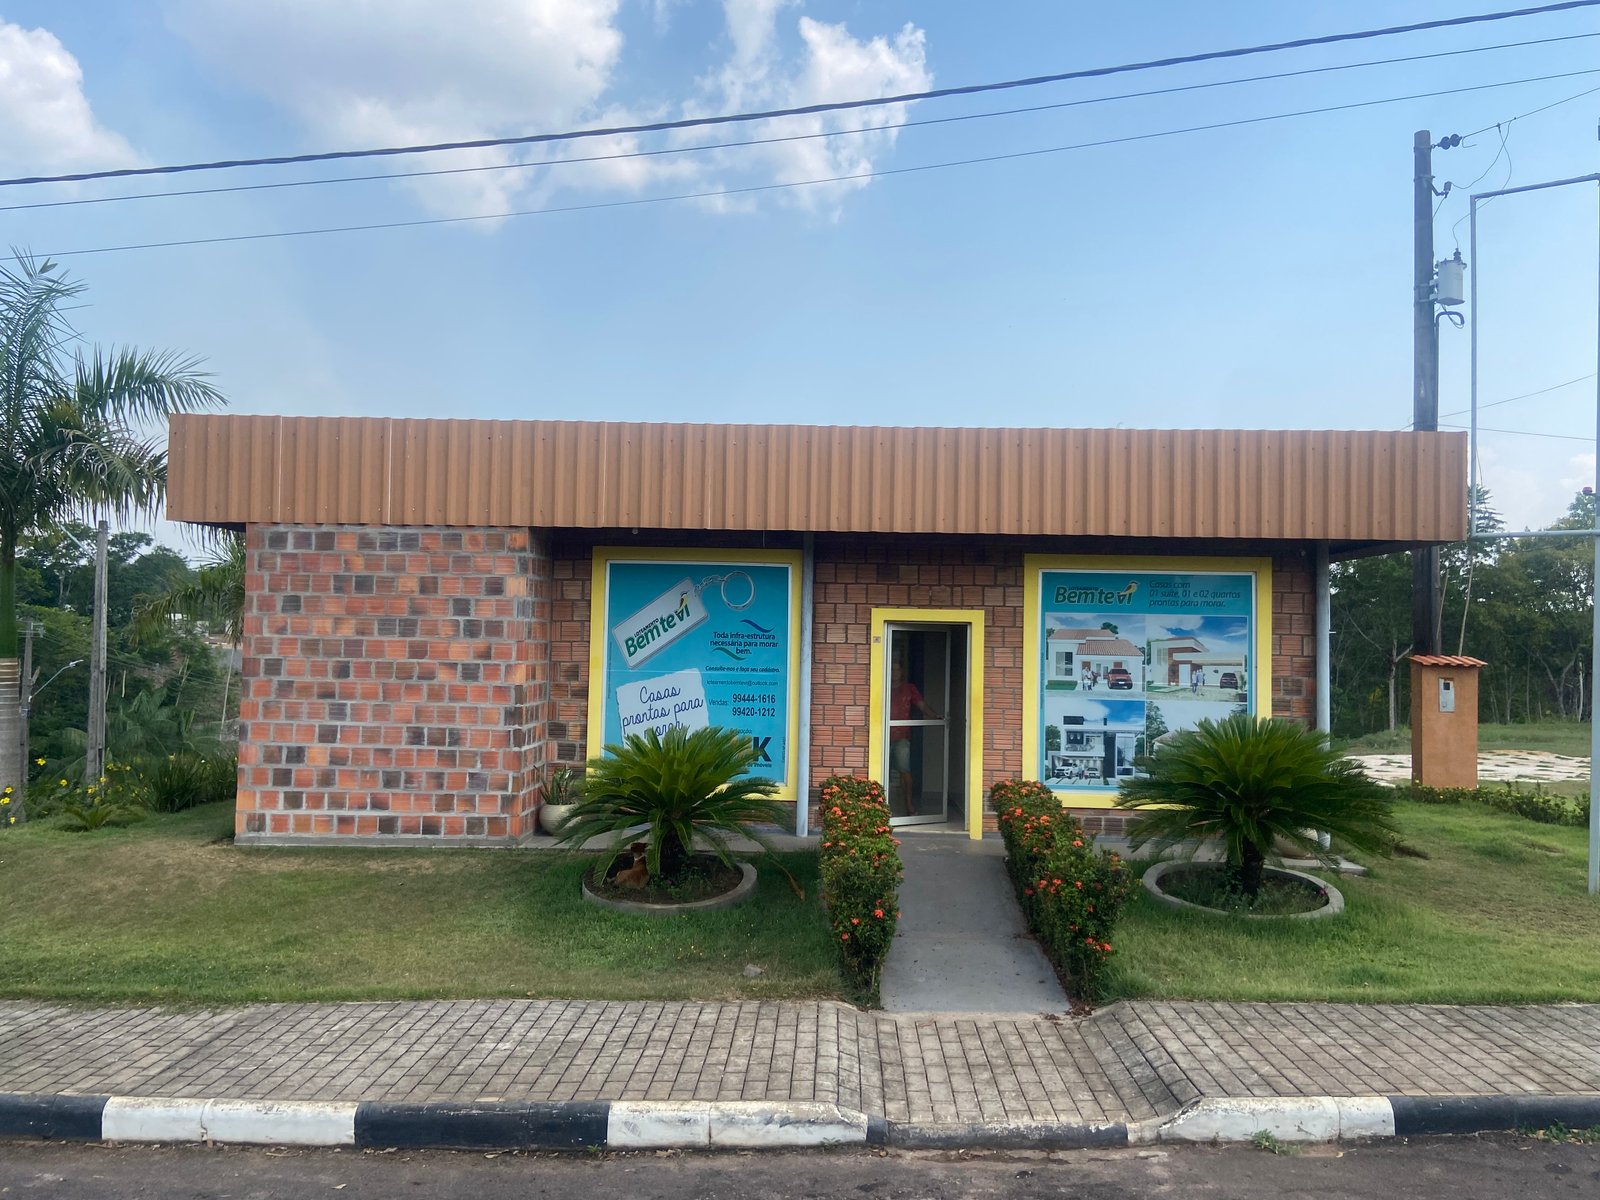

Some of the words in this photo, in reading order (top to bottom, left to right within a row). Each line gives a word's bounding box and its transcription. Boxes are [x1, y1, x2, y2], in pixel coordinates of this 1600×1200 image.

[1149, 581, 1171, 589] Casas
[1149, 589, 1158, 598] 01
[1182, 589, 1191, 598] 01
[1199, 590, 1210, 598] 02
[1210, 591, 1241, 600] quartos
[1149, 599, 1179, 608] prontas
[1180, 600, 1199, 608] para
[713, 631, 729, 639] Toda
[730, 632, 776, 640] infra-estrutura
[640, 686, 681, 704] Casas
[732, 693, 776, 704] 99444-1616
[622, 704, 671, 735] prontas
[674, 698, 704, 723] para
[732, 707, 776, 717] 99420-1212
[644, 721, 684, 739] orar
